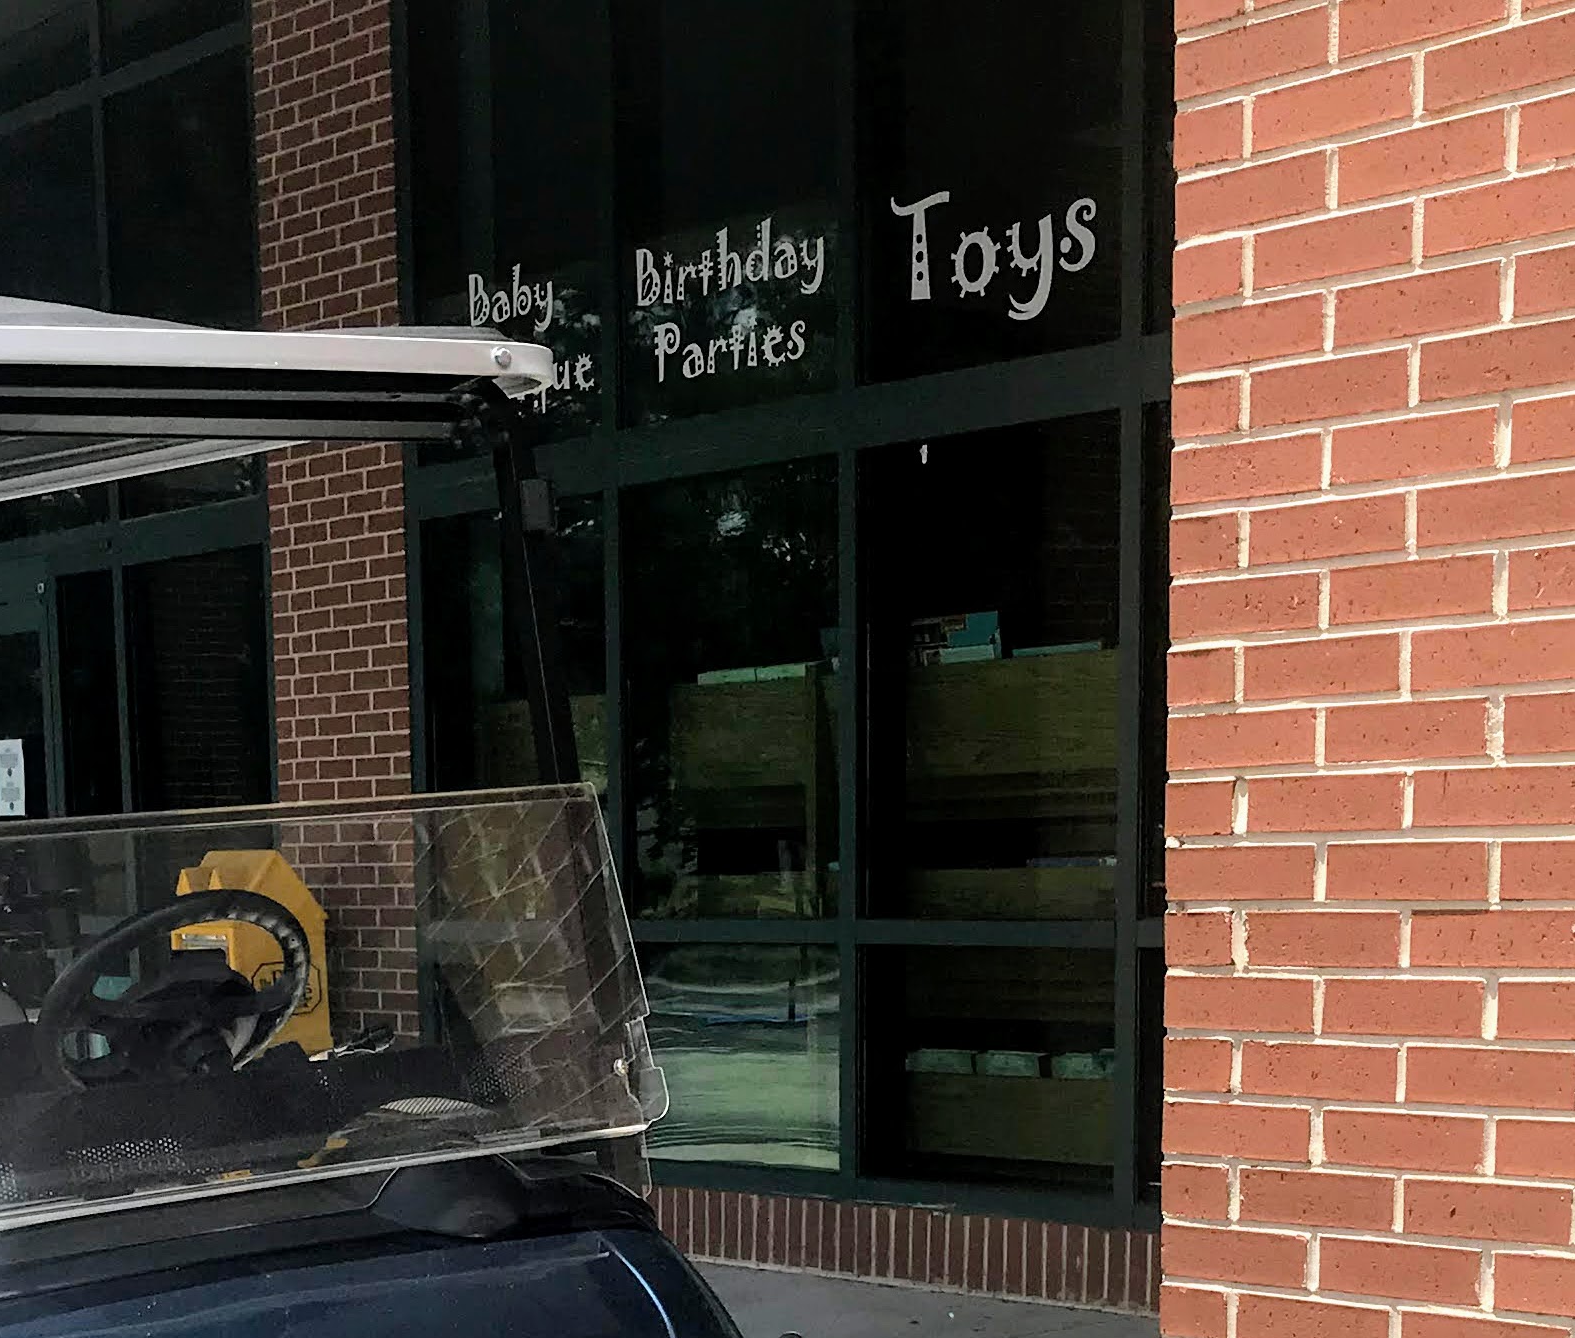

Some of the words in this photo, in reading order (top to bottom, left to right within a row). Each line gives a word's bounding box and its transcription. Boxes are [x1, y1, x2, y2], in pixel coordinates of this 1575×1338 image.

[634, 216, 826, 307] Birthday
[889, 190, 1097, 321] Toys
[468, 263, 553, 332] Baby
[653, 317, 807, 383] Parties
